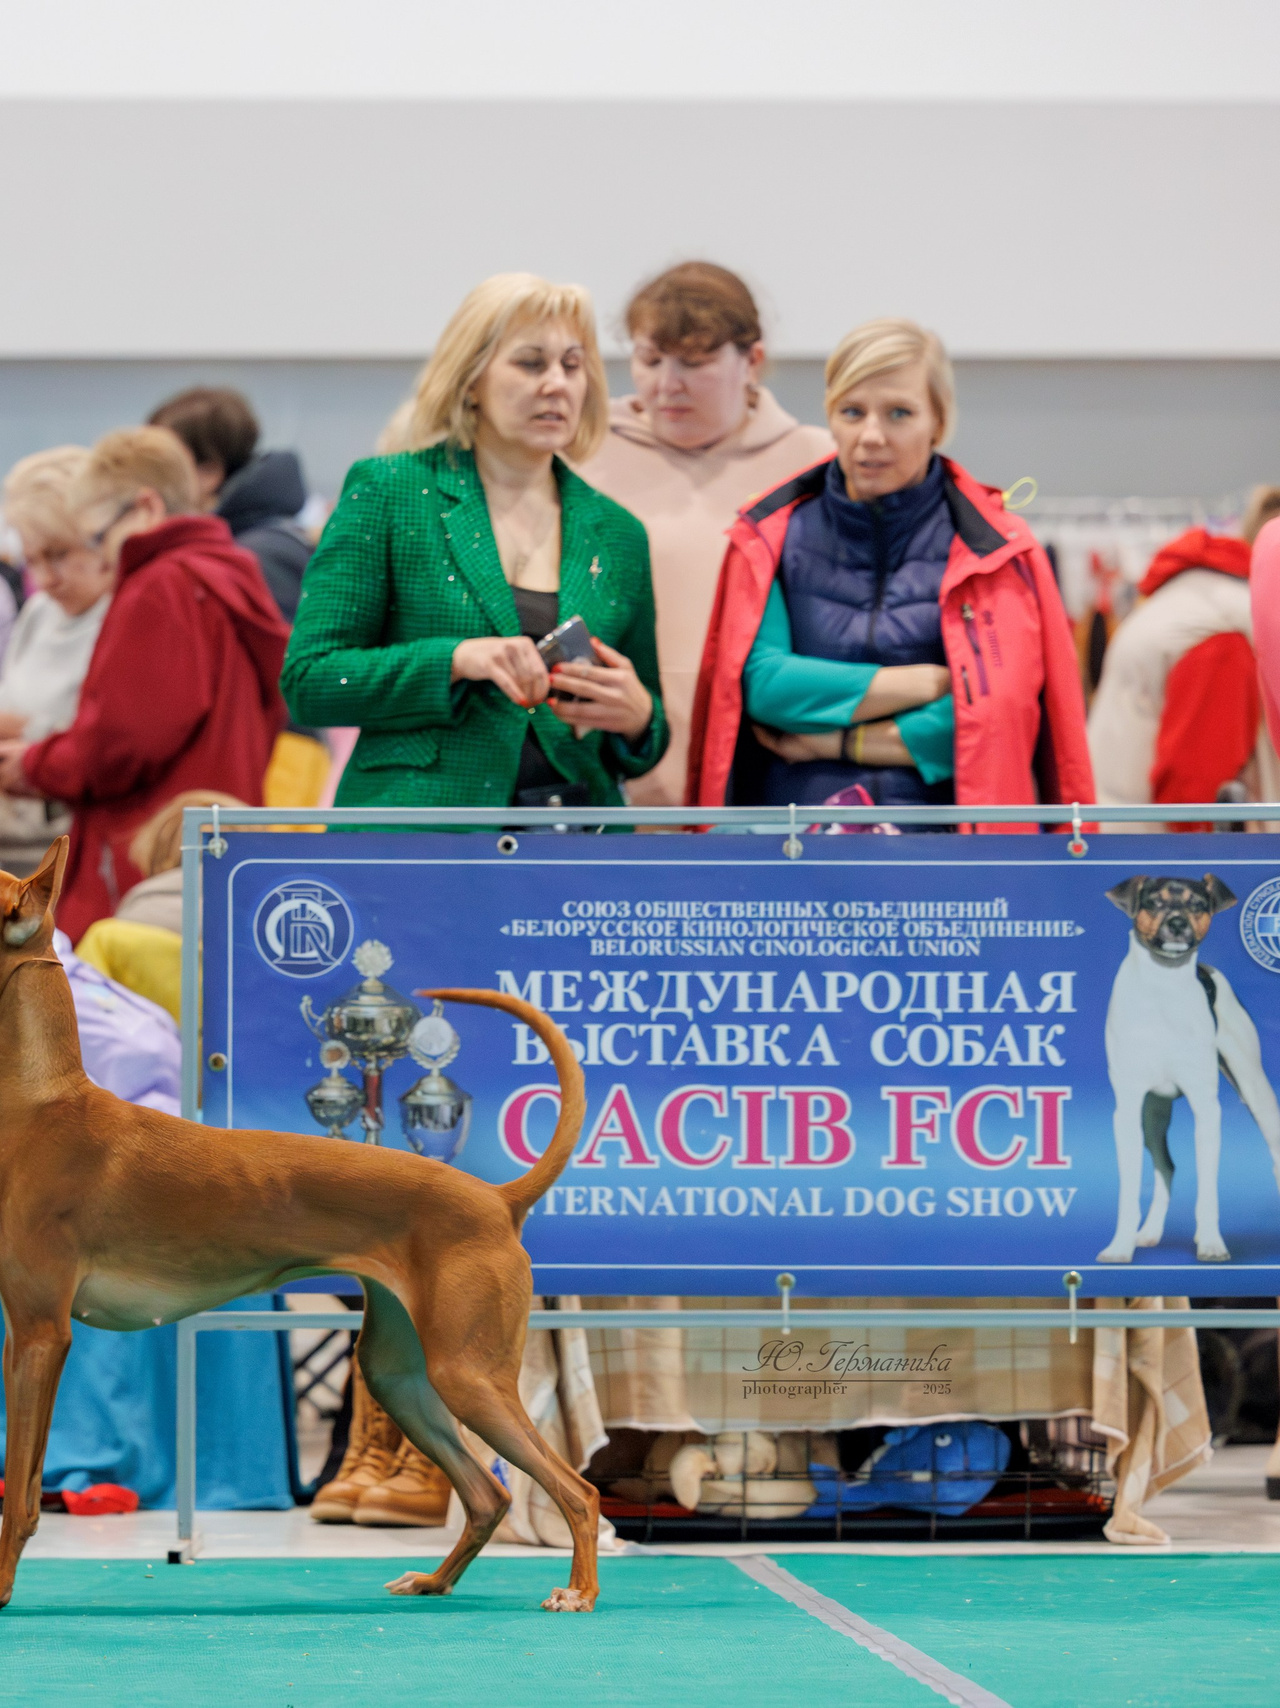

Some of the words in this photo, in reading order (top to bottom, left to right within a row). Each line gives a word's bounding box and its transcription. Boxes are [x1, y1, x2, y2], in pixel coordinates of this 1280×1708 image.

[562, 900, 631, 918] СОЮЗ
[634, 900, 829, 920] ОБЩЕСТВЕННЫХ
[832, 897, 1009, 920] ОБЪЕДИНЕНИЙ
[681, 919, 899, 938] КИНОЛОГИЧЕСКОЕ
[590, 939, 745, 957] BELORUSSIAN
[749, 939, 904, 957] CINOLOGICAL
[908, 939, 981, 957] UNION
[495, 970, 1078, 1022] МЕЖДУНАРОДНАЯ
[511, 1023, 841, 1066] ВЫСТАВКА
[870, 1023, 1066, 1067] СОБАК
[497, 1083, 857, 1170] CACIB
[880, 1084, 1072, 1171] FCI
[528, 1186, 834, 1217] TERNATIONAL
[842, 1186, 937, 1218] DOG
[946, 1186, 1078, 1218] SHOW
